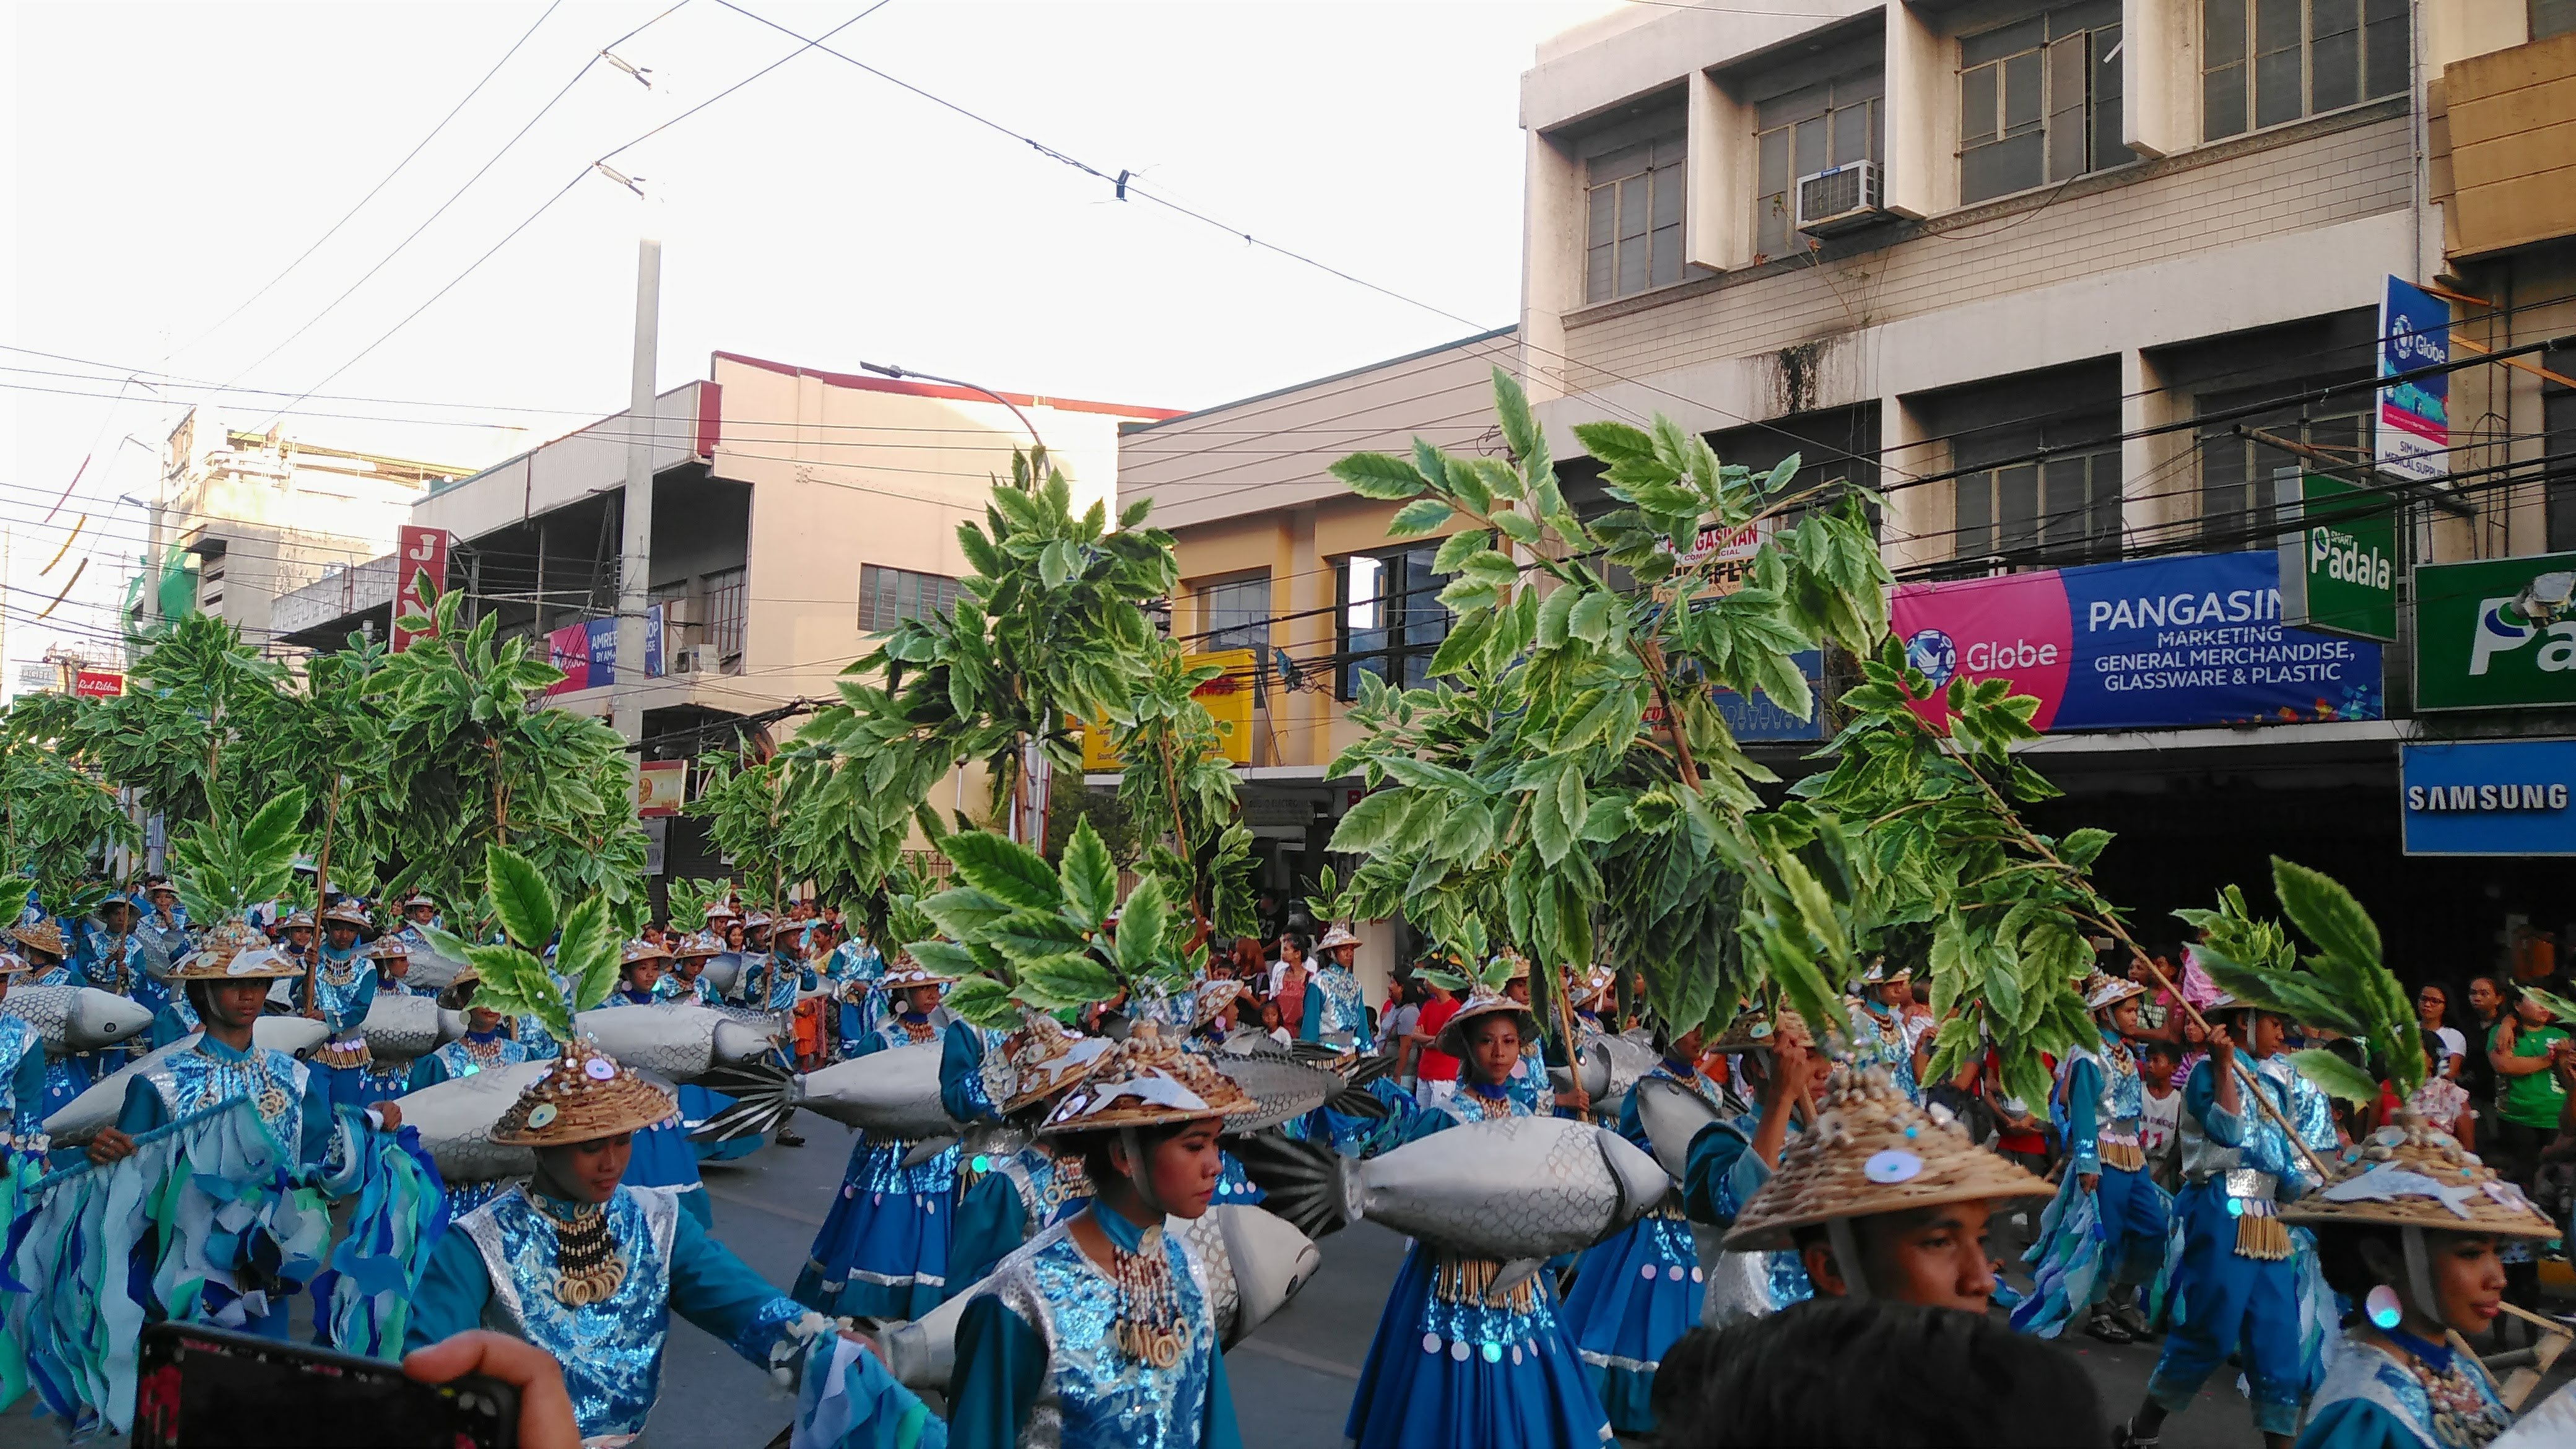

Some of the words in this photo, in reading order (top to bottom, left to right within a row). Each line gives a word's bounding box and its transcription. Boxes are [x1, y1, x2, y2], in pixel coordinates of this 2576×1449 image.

[2415, 334, 2445, 364] Globe
[2400, 441, 2413, 455] SIM
[2331, 530, 2354, 546] SMART
[1684, 549, 1740, 561] COMCIAL
[2311, 526, 2390, 590] Padala
[2157, 625, 2282, 649] MARKETING
[596, 651, 603, 663] BY
[1967, 638, 2058, 671] Globe
[2094, 652, 2186, 672] GENERAL
[2190, 641, 2356, 666] MERCHANDISE,
[20, 669, 51, 679] LIGHT
[78, 679, 95, 689] Red
[95, 681, 120, 692] Ribbon
[2105, 668, 2227, 692] GLASSWARE
[2232, 668, 2247, 685] &
[2252, 663, 2342, 684] PLASTIC
[2408, 783, 2567, 810] SAMSUNG
